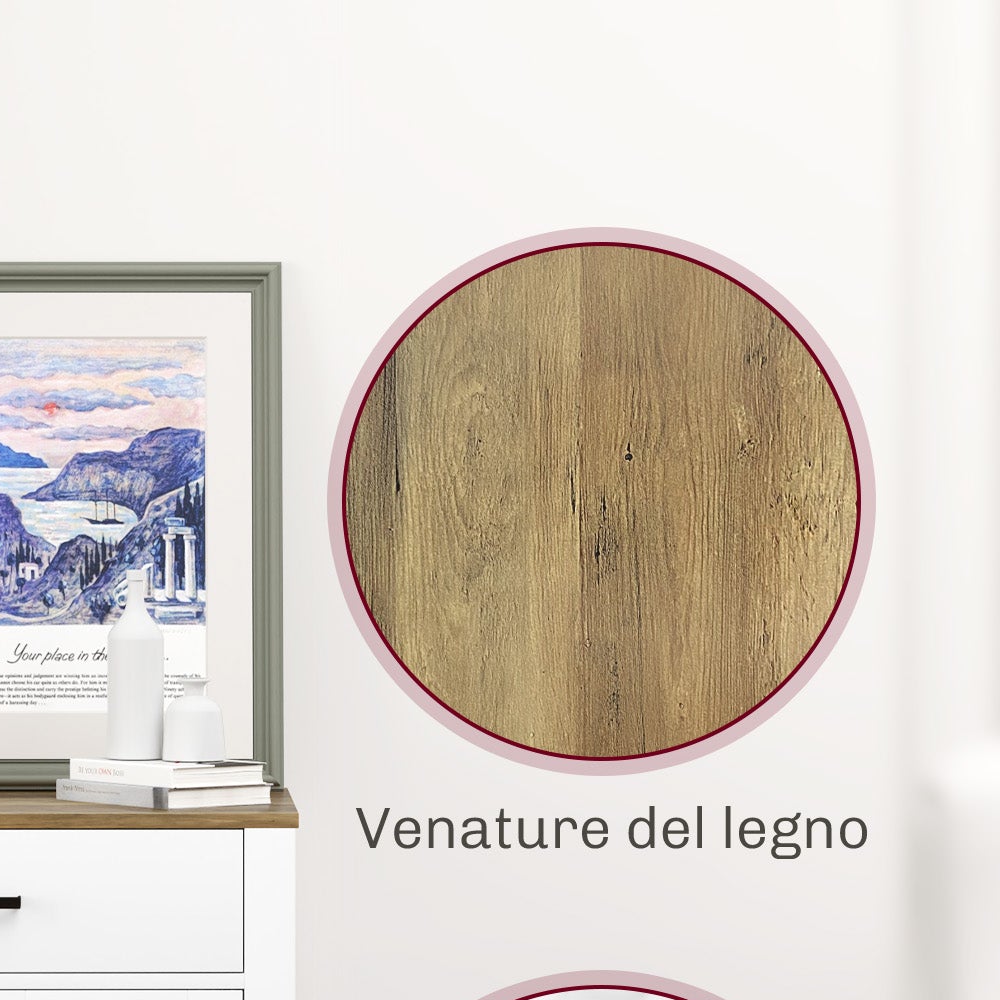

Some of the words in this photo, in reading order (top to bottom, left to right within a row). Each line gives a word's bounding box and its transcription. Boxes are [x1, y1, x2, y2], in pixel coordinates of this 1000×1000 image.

[6, 642, 42, 664] Your
[40, 647, 75, 665] place
[77, 650, 89, 661] in
